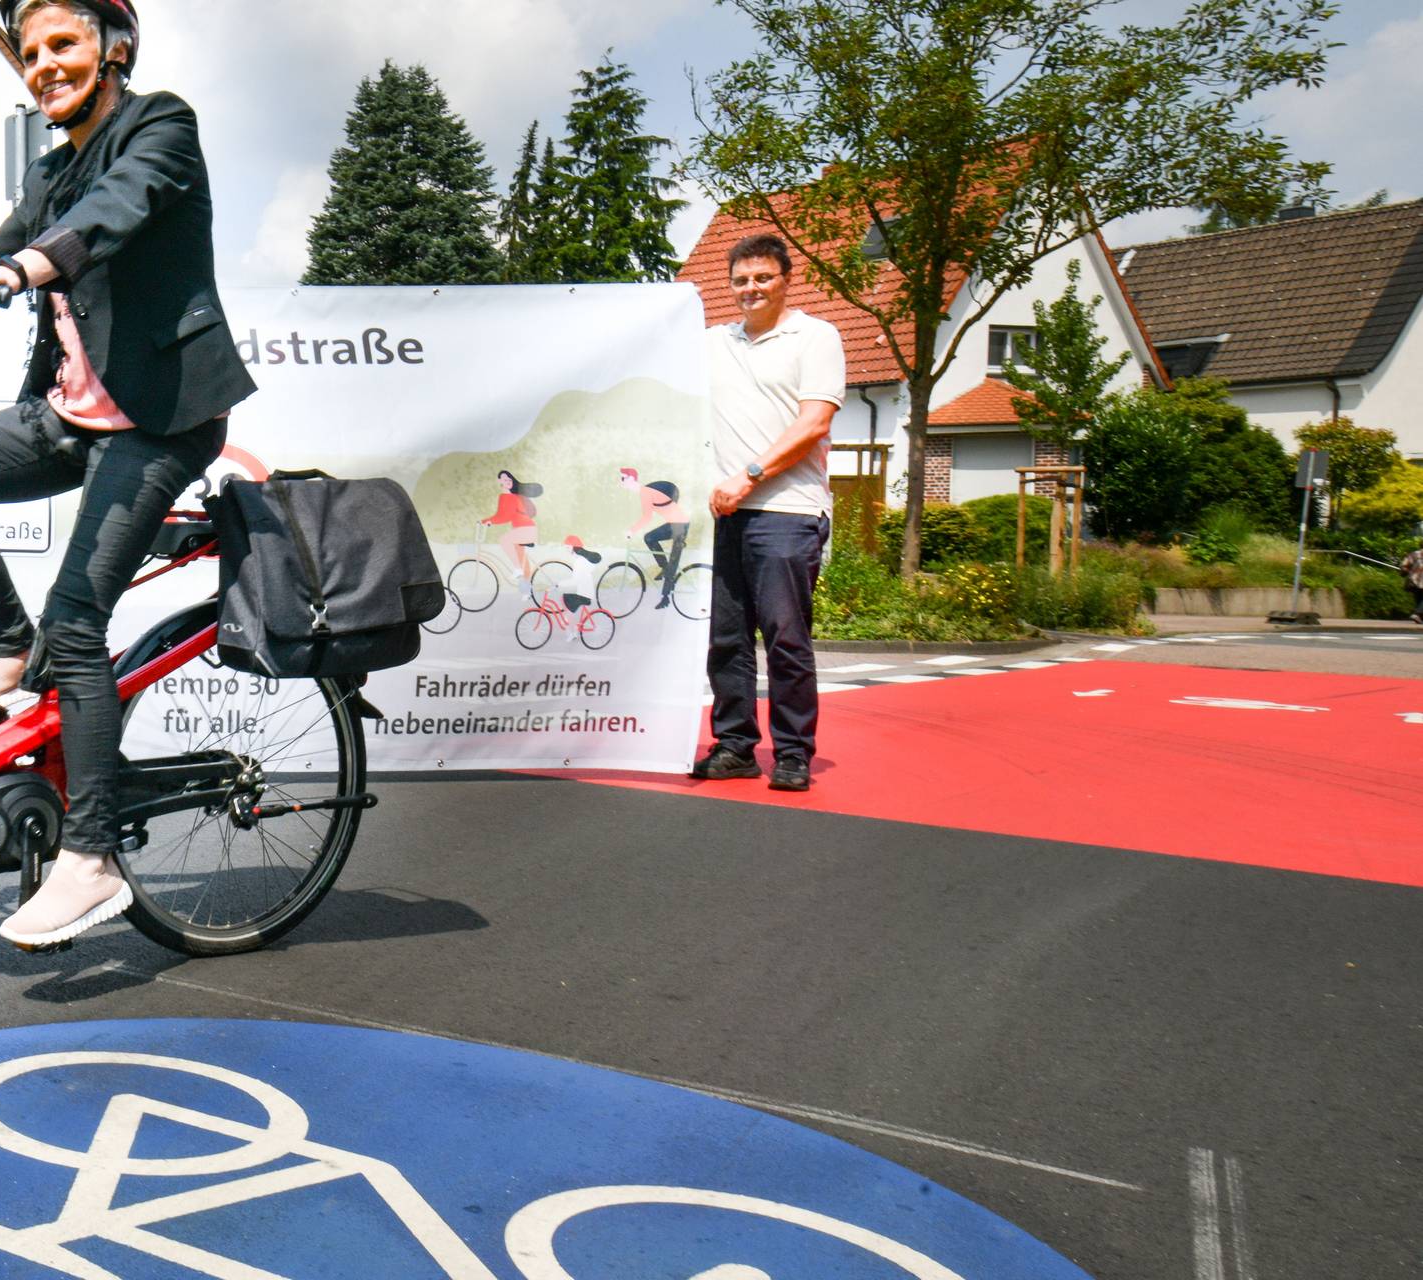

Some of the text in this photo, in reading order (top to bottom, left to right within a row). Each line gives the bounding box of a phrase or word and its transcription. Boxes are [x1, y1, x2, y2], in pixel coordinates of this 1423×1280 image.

[235, 327, 424, 365] dstraße
[248, 674, 280, 696] 30
[415, 674, 611, 698] Fahrräder dürfen
[163, 708, 265, 734] für alle.
[375, 709, 646, 735] nebeneinander fahren.
